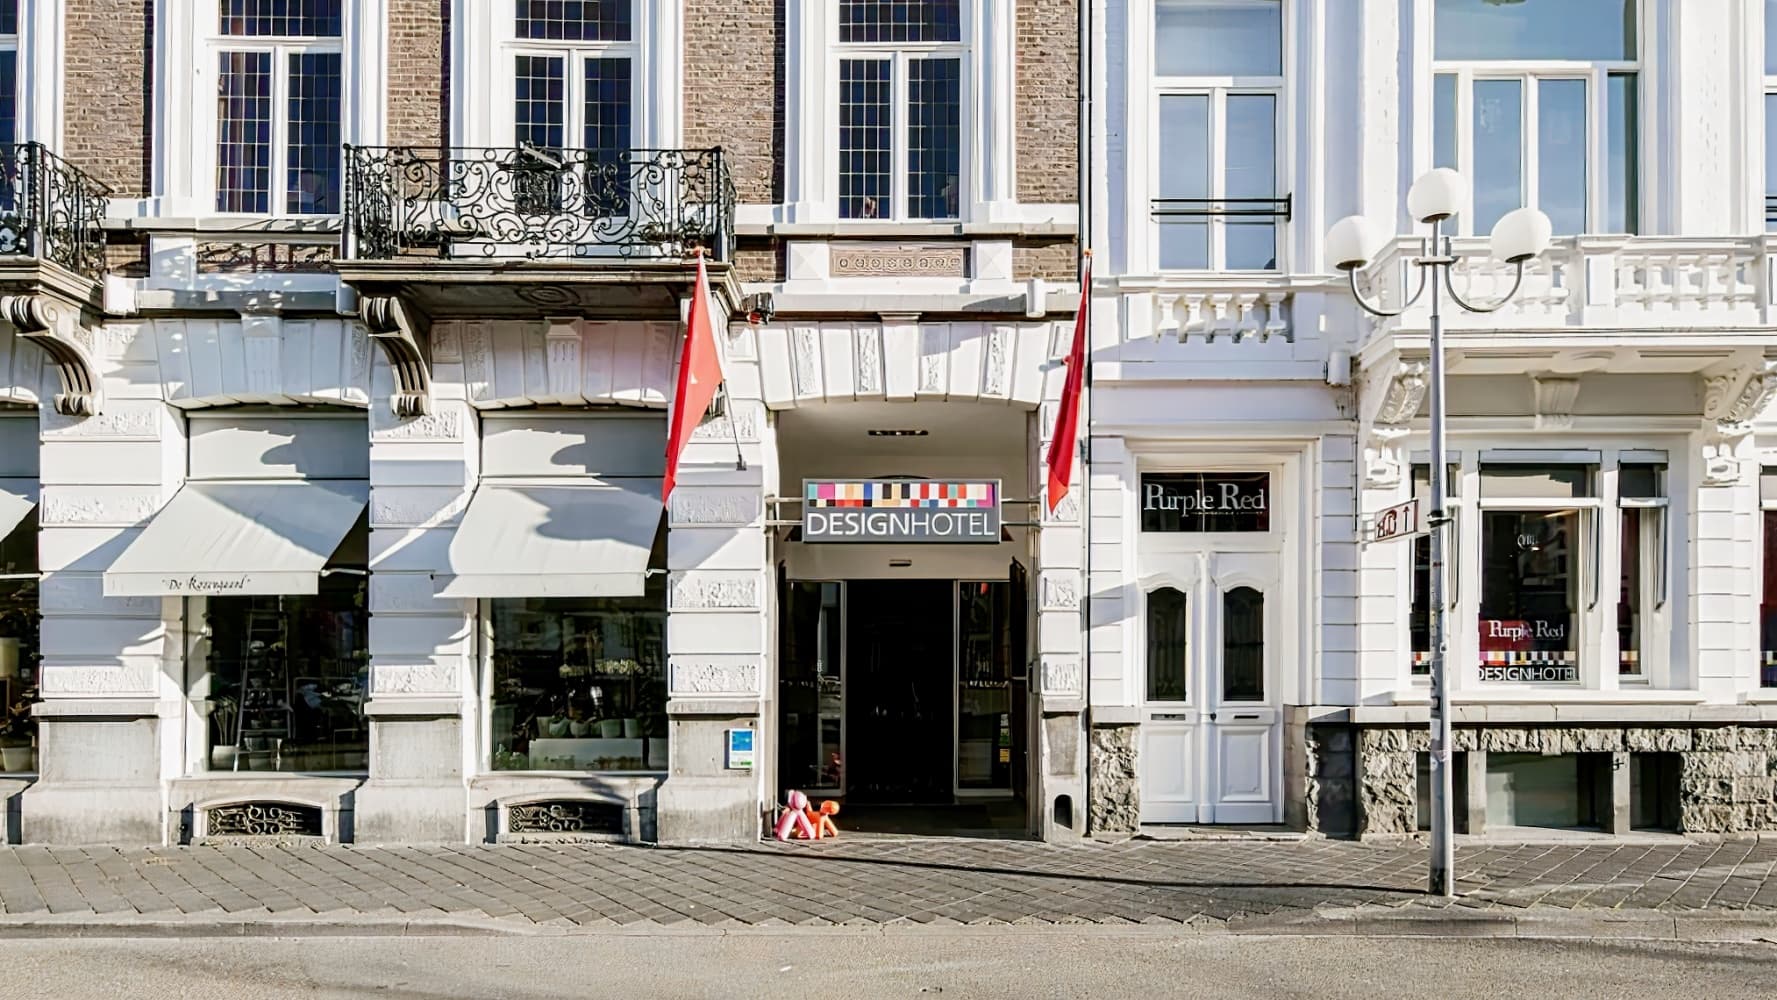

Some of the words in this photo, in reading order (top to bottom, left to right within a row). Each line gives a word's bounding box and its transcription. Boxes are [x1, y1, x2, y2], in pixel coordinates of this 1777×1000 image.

[1143, 483, 1215, 517] Purple
[1217, 483, 1266, 510] Red
[806, 512, 996, 536] DESIGNHOTEL
[1487, 620, 1533, 642] Purple
[1535, 620, 1564, 638] Red
